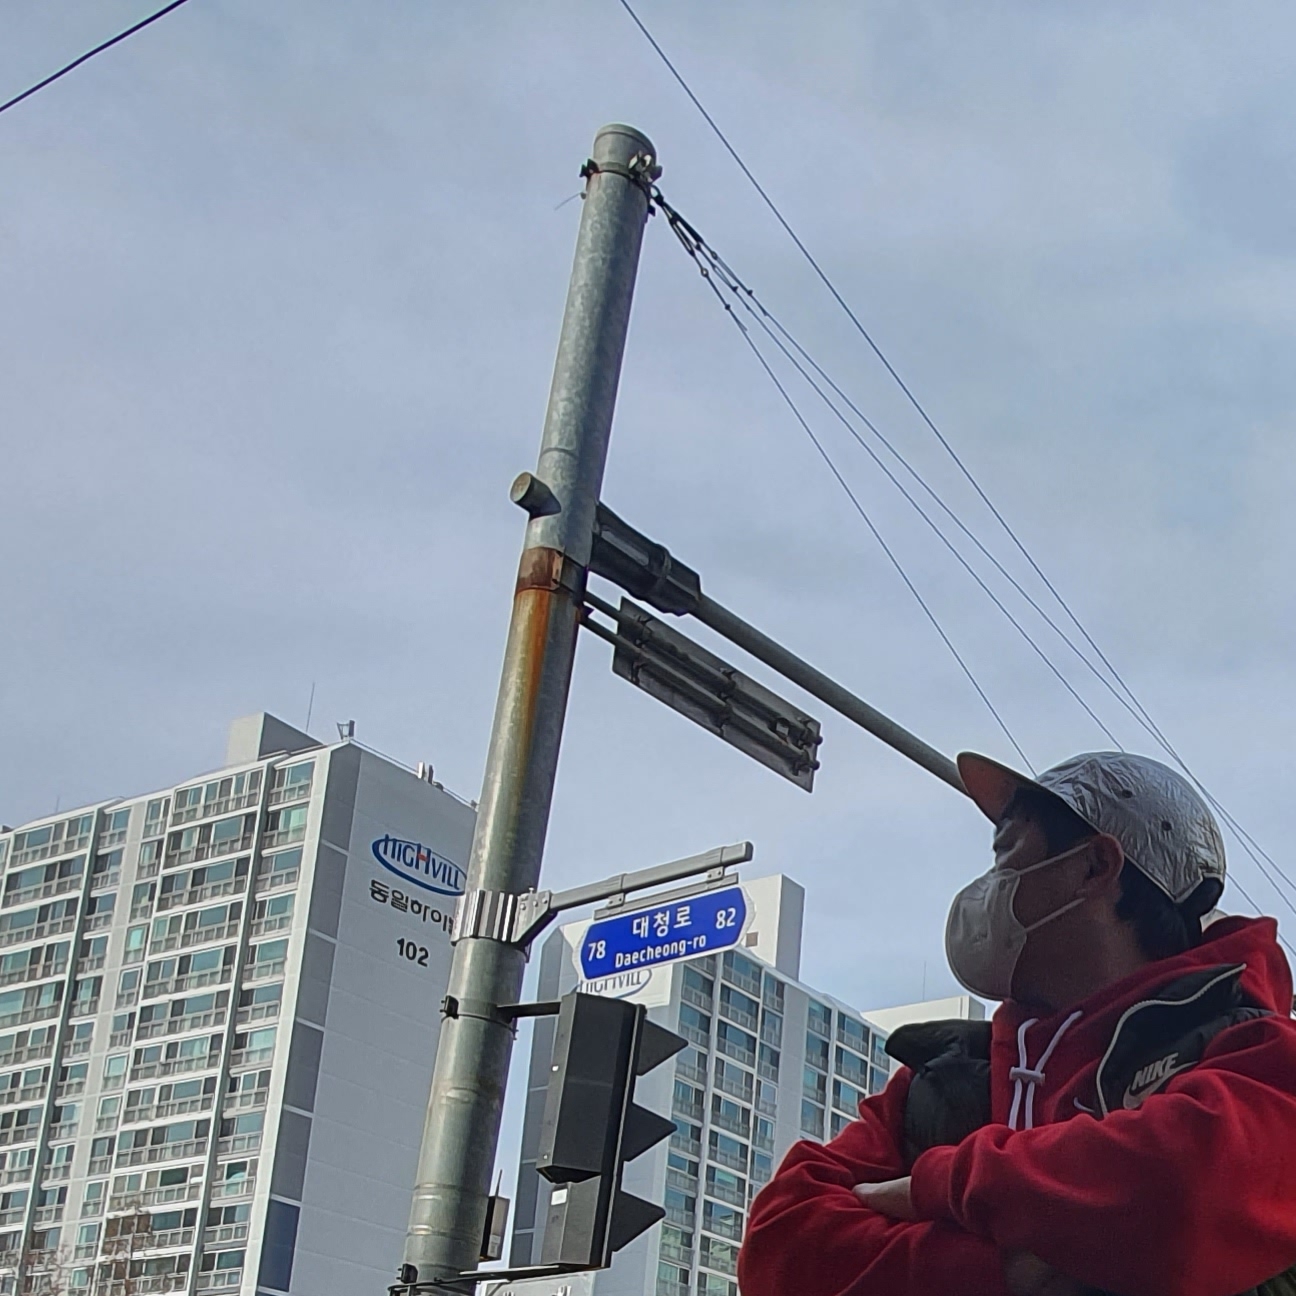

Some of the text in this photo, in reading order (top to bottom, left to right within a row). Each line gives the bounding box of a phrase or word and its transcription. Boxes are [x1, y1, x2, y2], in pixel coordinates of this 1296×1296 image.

[383, 833, 460, 891] HIGHVILL
[632, 906, 736, 938] 대청로 82
[397, 938, 429, 968] 102
[588, 935, 706, 968] 78 Daecheong-ro
[1131, 1052, 1179, 1091] NIKE
